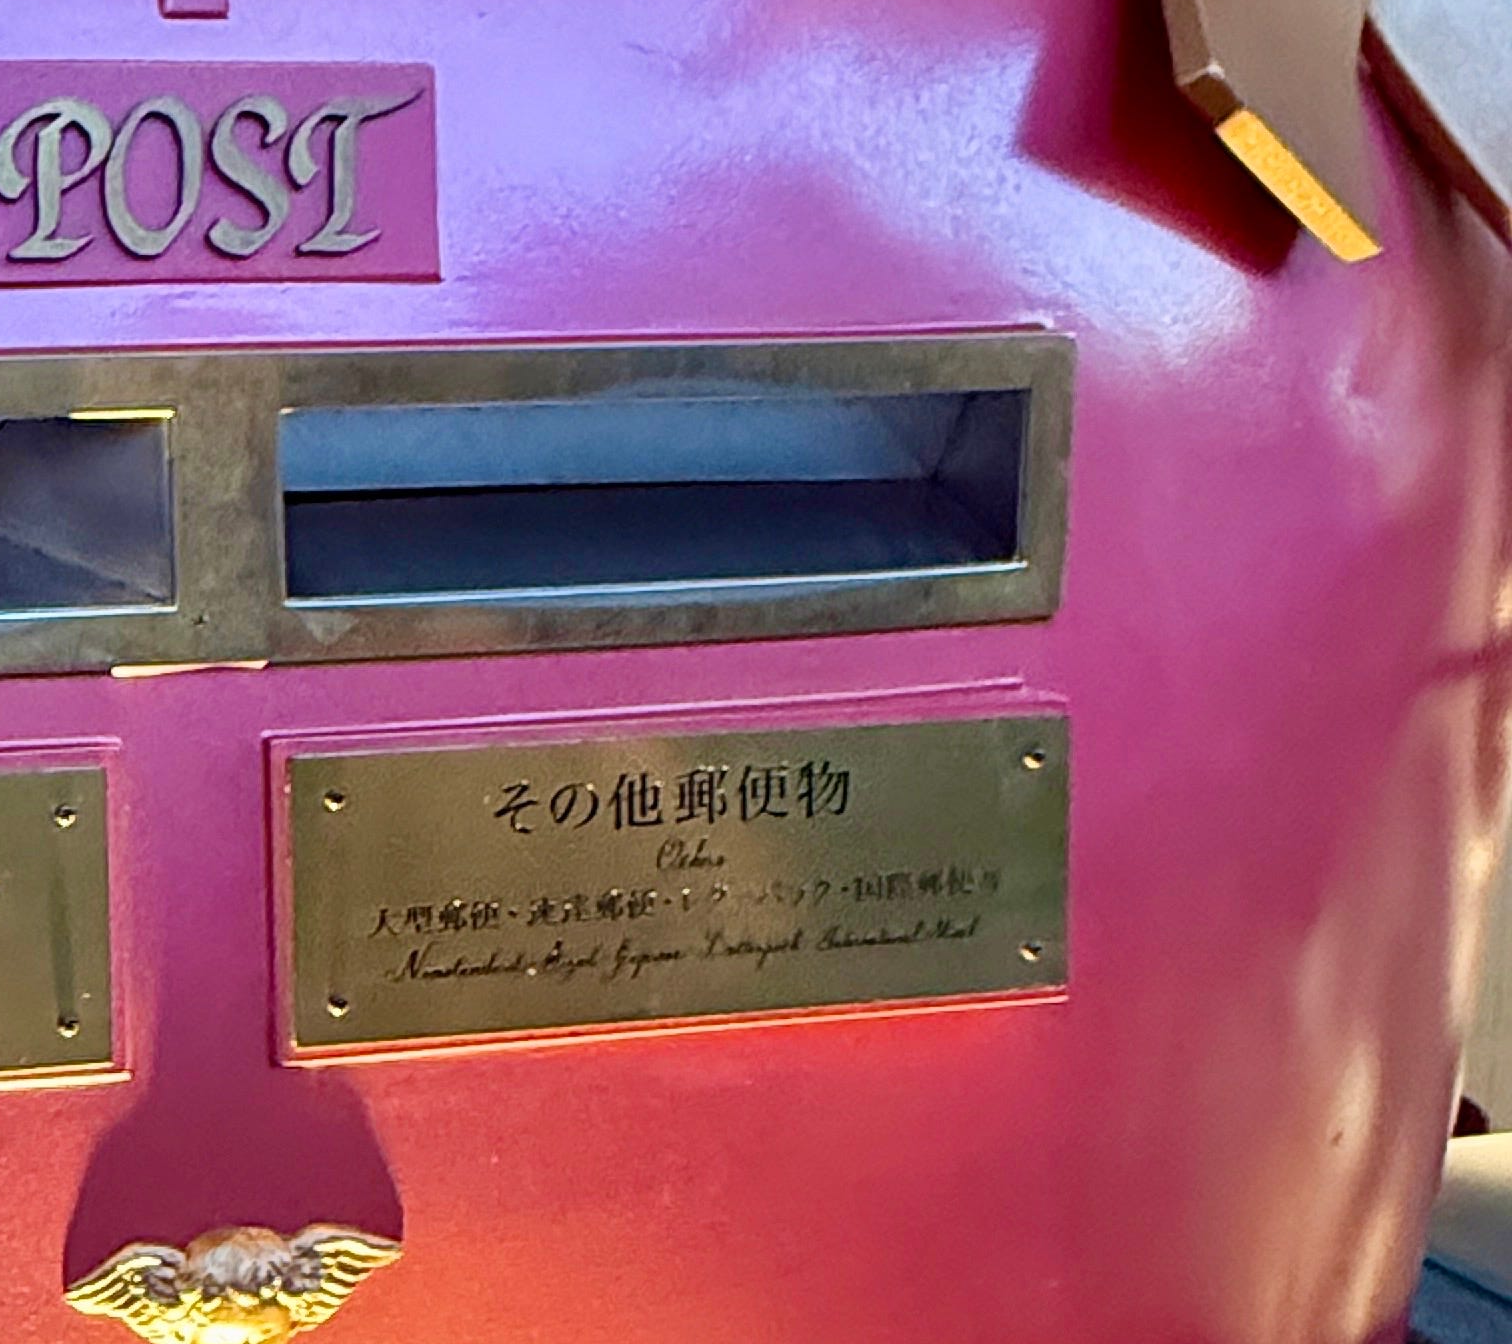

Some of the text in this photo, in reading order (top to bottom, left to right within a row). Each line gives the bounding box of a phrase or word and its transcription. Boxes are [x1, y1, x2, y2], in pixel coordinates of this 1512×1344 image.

[493, 759, 852, 836] その他郵便物
